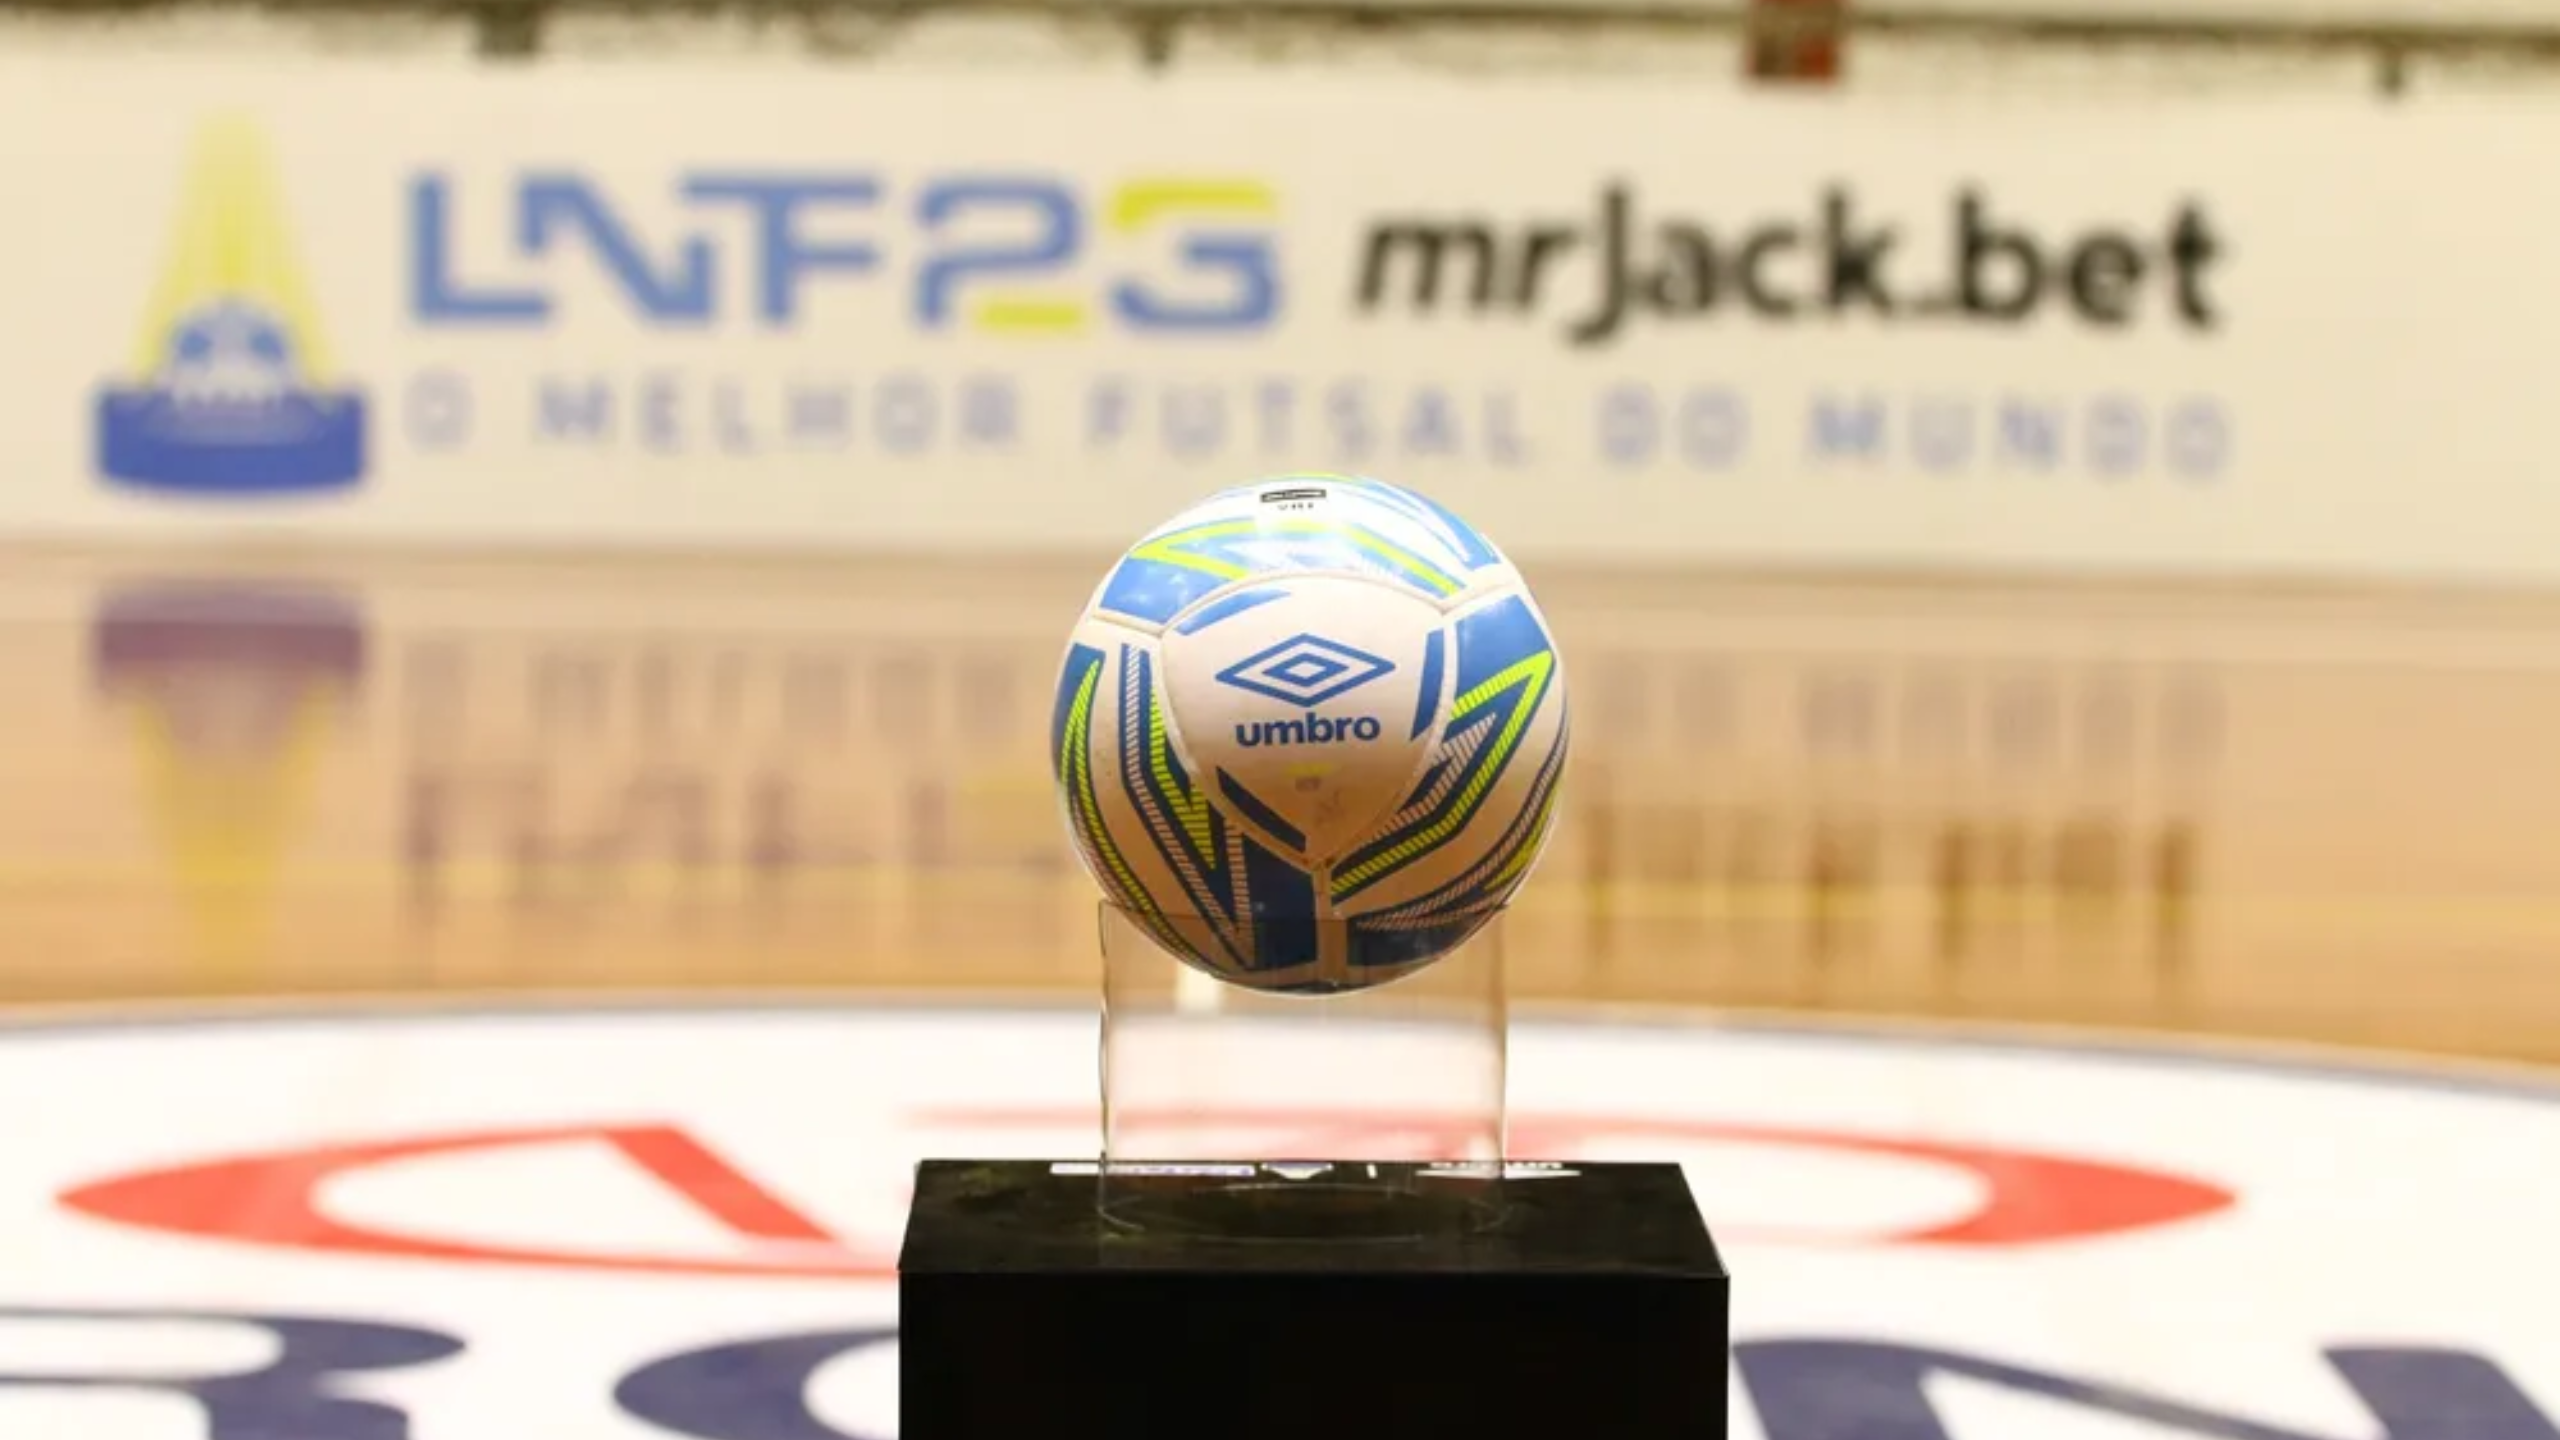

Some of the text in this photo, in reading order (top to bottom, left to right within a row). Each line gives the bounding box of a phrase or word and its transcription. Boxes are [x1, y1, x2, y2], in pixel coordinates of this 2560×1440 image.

[409, 172, 1279, 331] LNF23
[1354, 180, 2226, 345] mrJack.bet
[404, 370, 2230, 482] O MELHOR FUTSAL DO MUNDO
[1235, 711, 1381, 746] umbro
